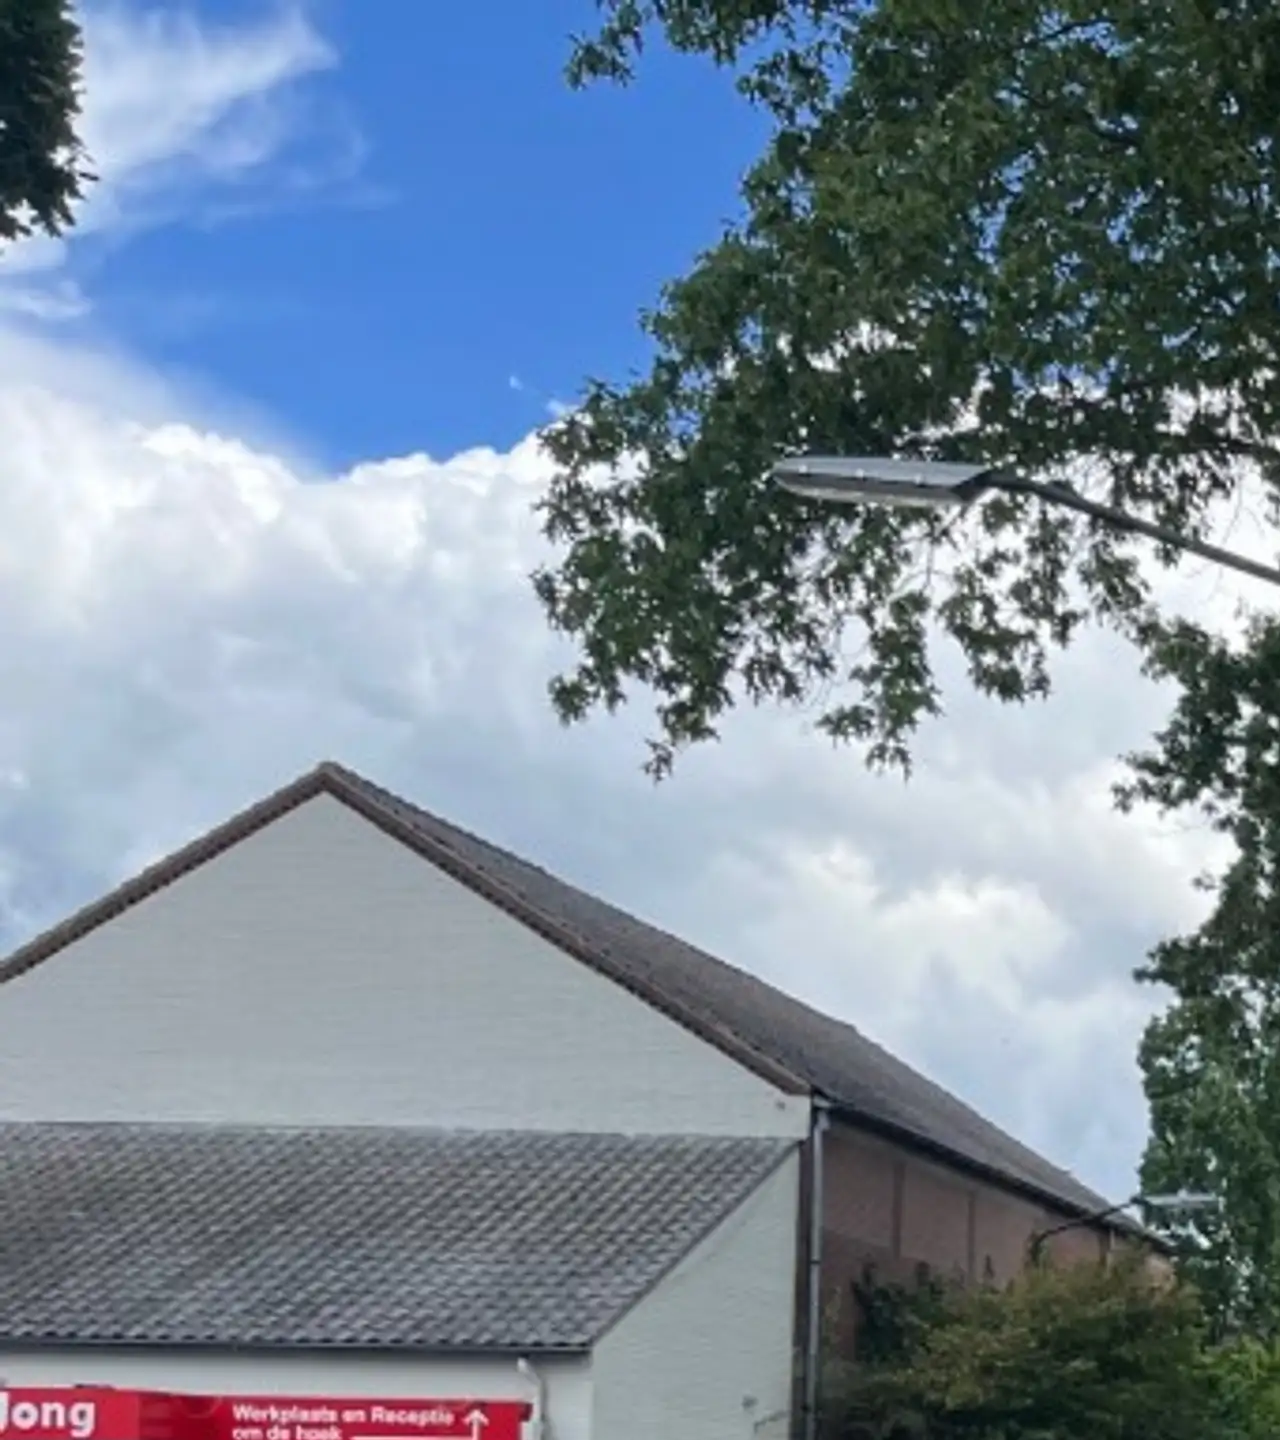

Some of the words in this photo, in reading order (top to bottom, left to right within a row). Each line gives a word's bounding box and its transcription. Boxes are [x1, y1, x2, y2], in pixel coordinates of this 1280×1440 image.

[232, 1404, 338, 1425] Werkplaats
[342, 1409, 366, 1422] en
[371, 1405, 455, 1427] Receptie
[232, 1428, 264, 1440] om
[266, 1424, 291, 1440] de
[295, 1424, 343, 1440] hoek
